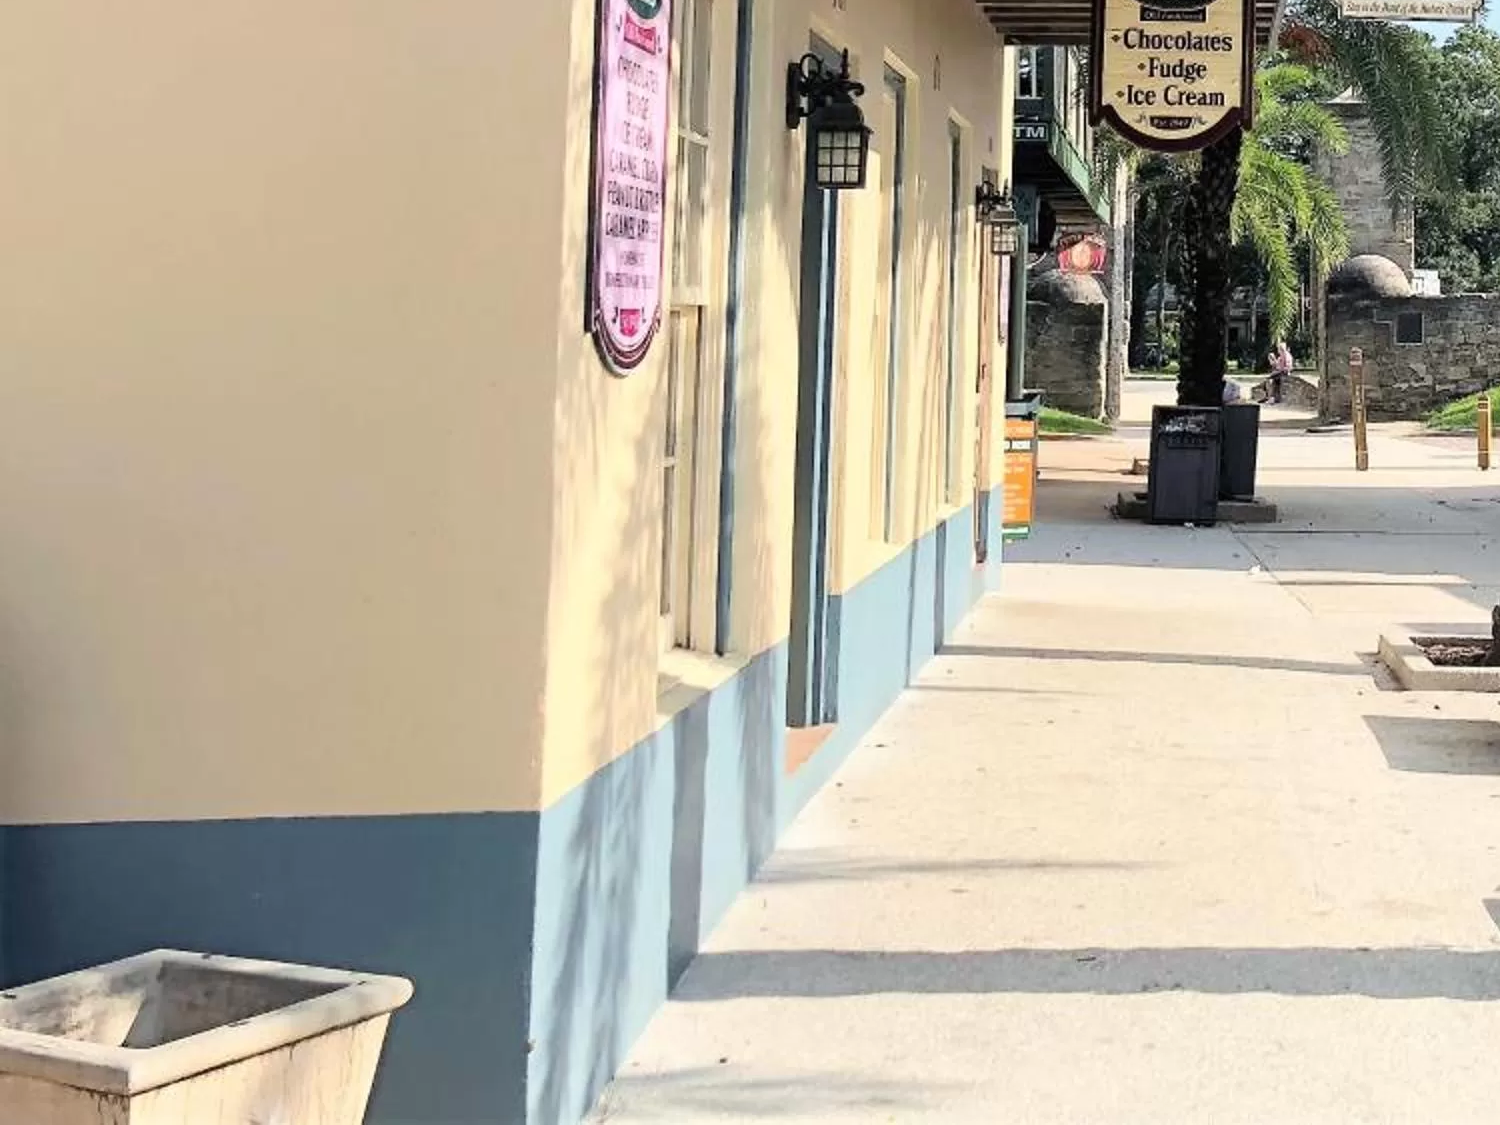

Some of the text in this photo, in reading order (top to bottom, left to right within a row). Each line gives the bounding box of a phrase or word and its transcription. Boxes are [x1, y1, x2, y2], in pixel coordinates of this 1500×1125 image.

[1123, 28, 1233, 52] Chocolates
[1147, 57, 1208, 84] Fudge
[1126, 84, 1226, 107] Ice Cream
[1012, 126, 1045, 138] TM
